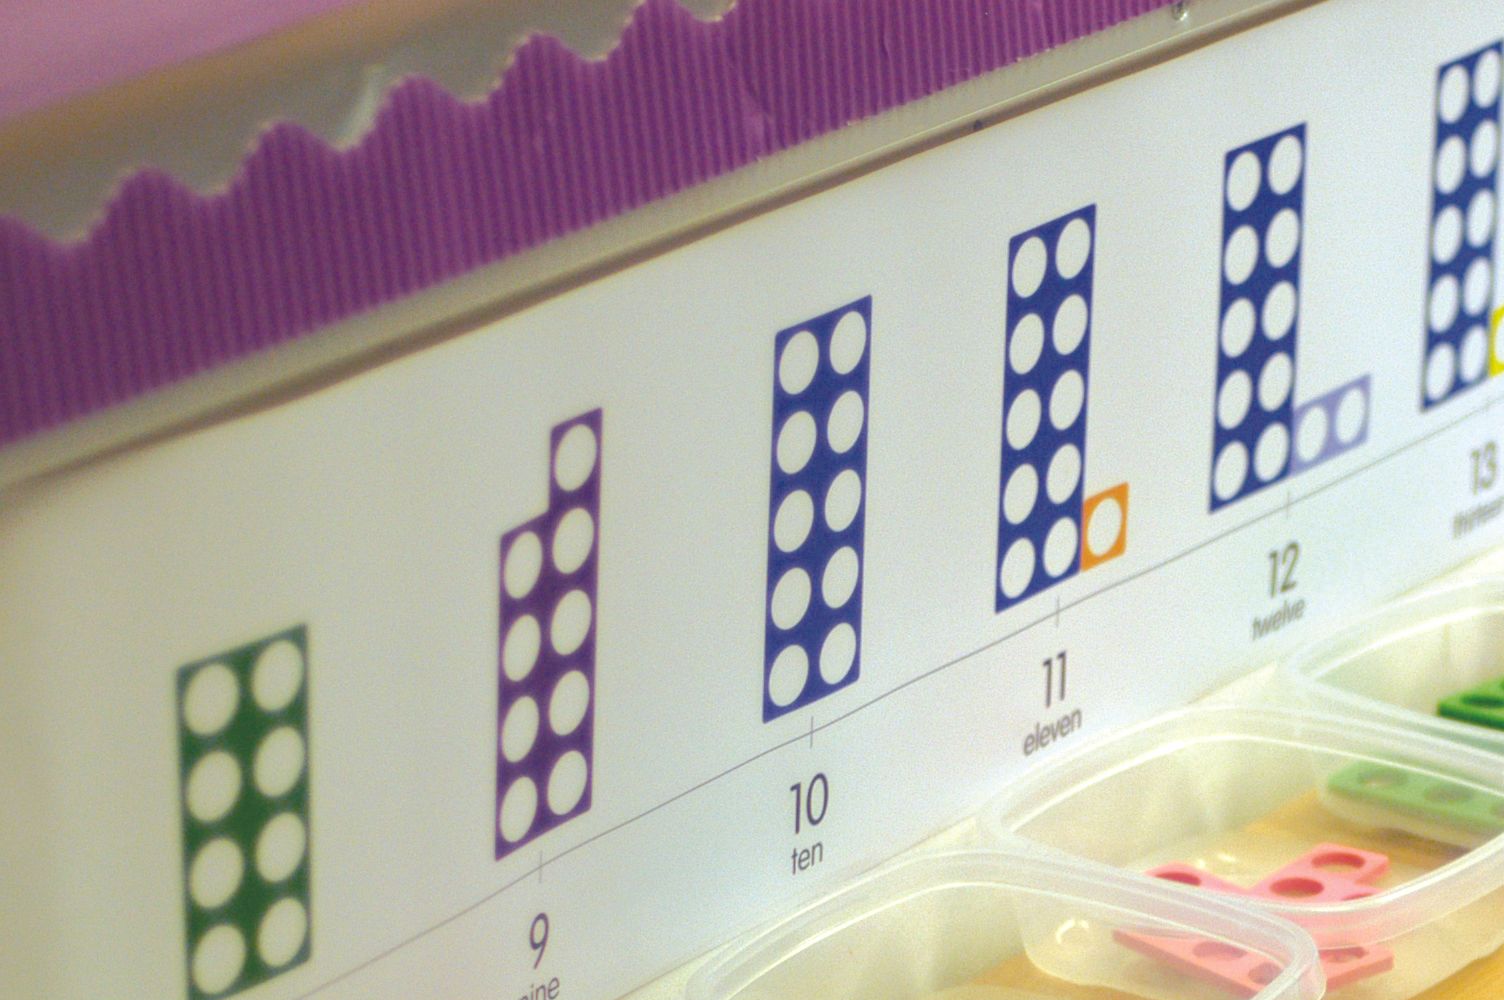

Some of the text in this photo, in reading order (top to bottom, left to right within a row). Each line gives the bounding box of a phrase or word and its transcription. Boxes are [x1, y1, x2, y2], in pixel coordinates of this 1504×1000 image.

[1471, 441, 1497, 496] 13
[1269, 542, 1299, 599] 12
[1252, 599, 1306, 641] twelve
[1043, 651, 1067, 708] 11
[1023, 709, 1082, 757] eleven
[790, 772, 828, 834] 10
[791, 841, 823, 875] ten
[529, 912, 549, 970] 9
